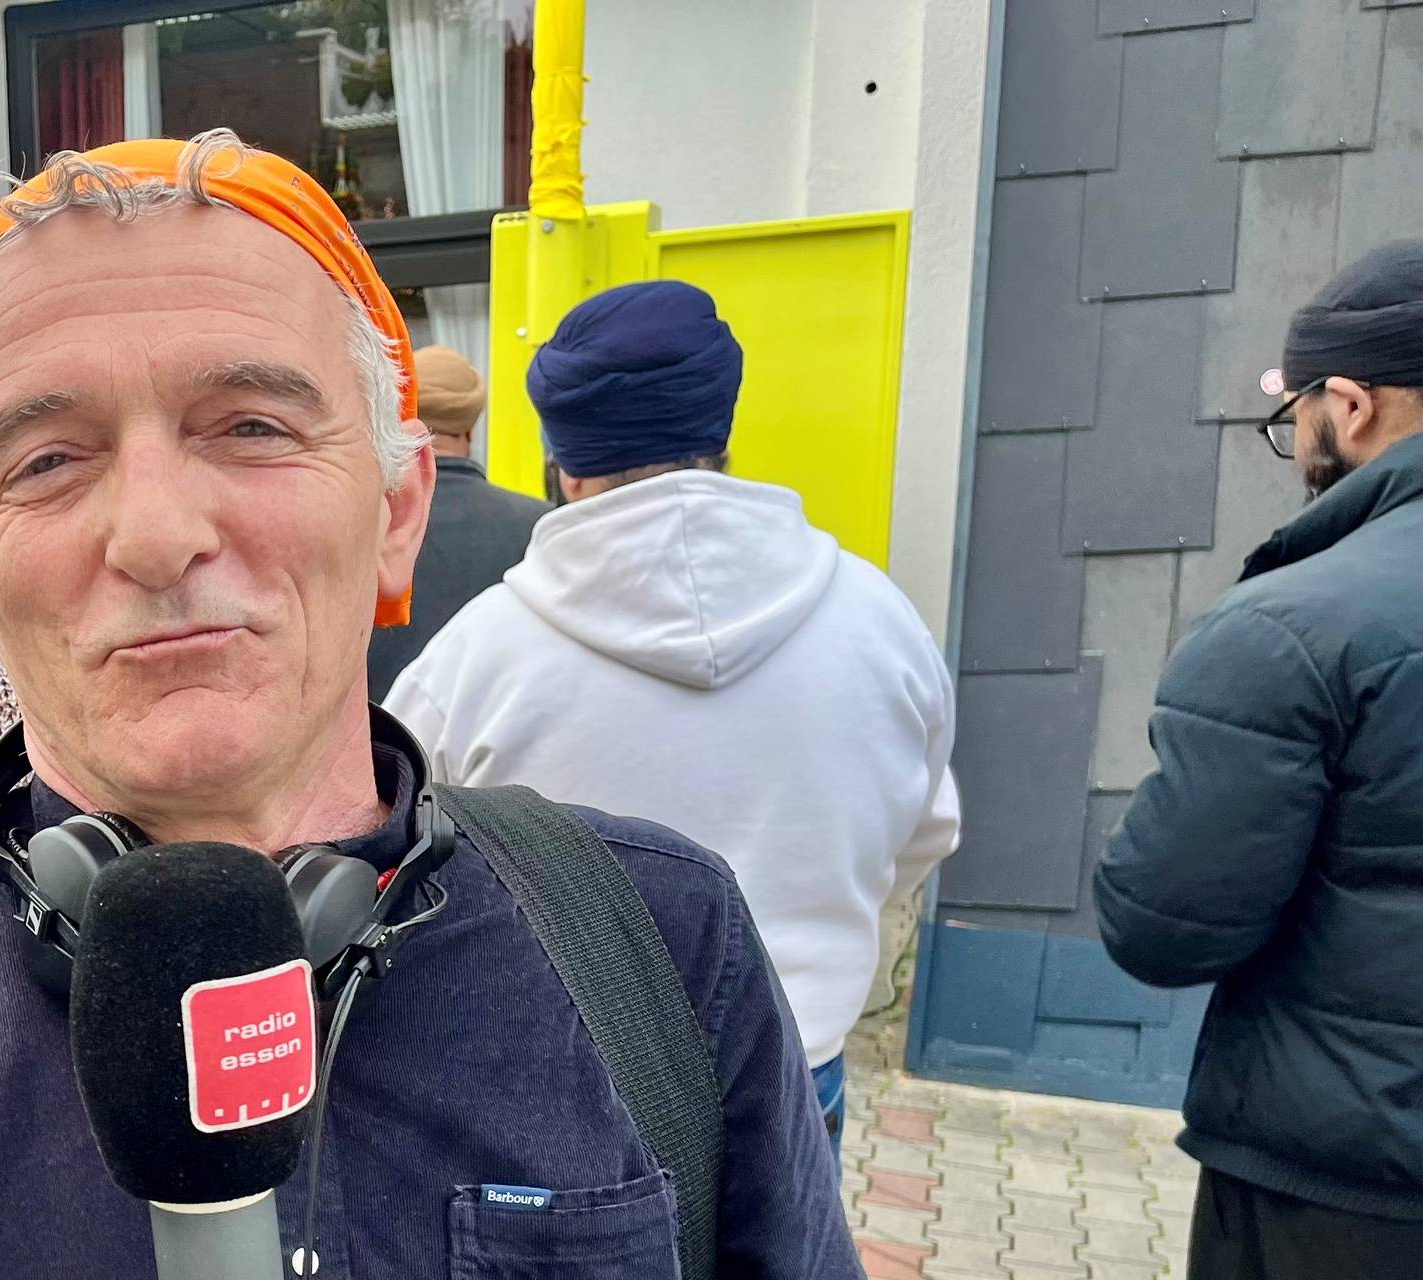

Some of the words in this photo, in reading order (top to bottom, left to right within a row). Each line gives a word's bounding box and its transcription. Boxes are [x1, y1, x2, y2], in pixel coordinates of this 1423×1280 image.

[224, 1011, 296, 1042] radio
[220, 1038, 302, 1071] essen
[487, 1189, 533, 1205] Barbour
